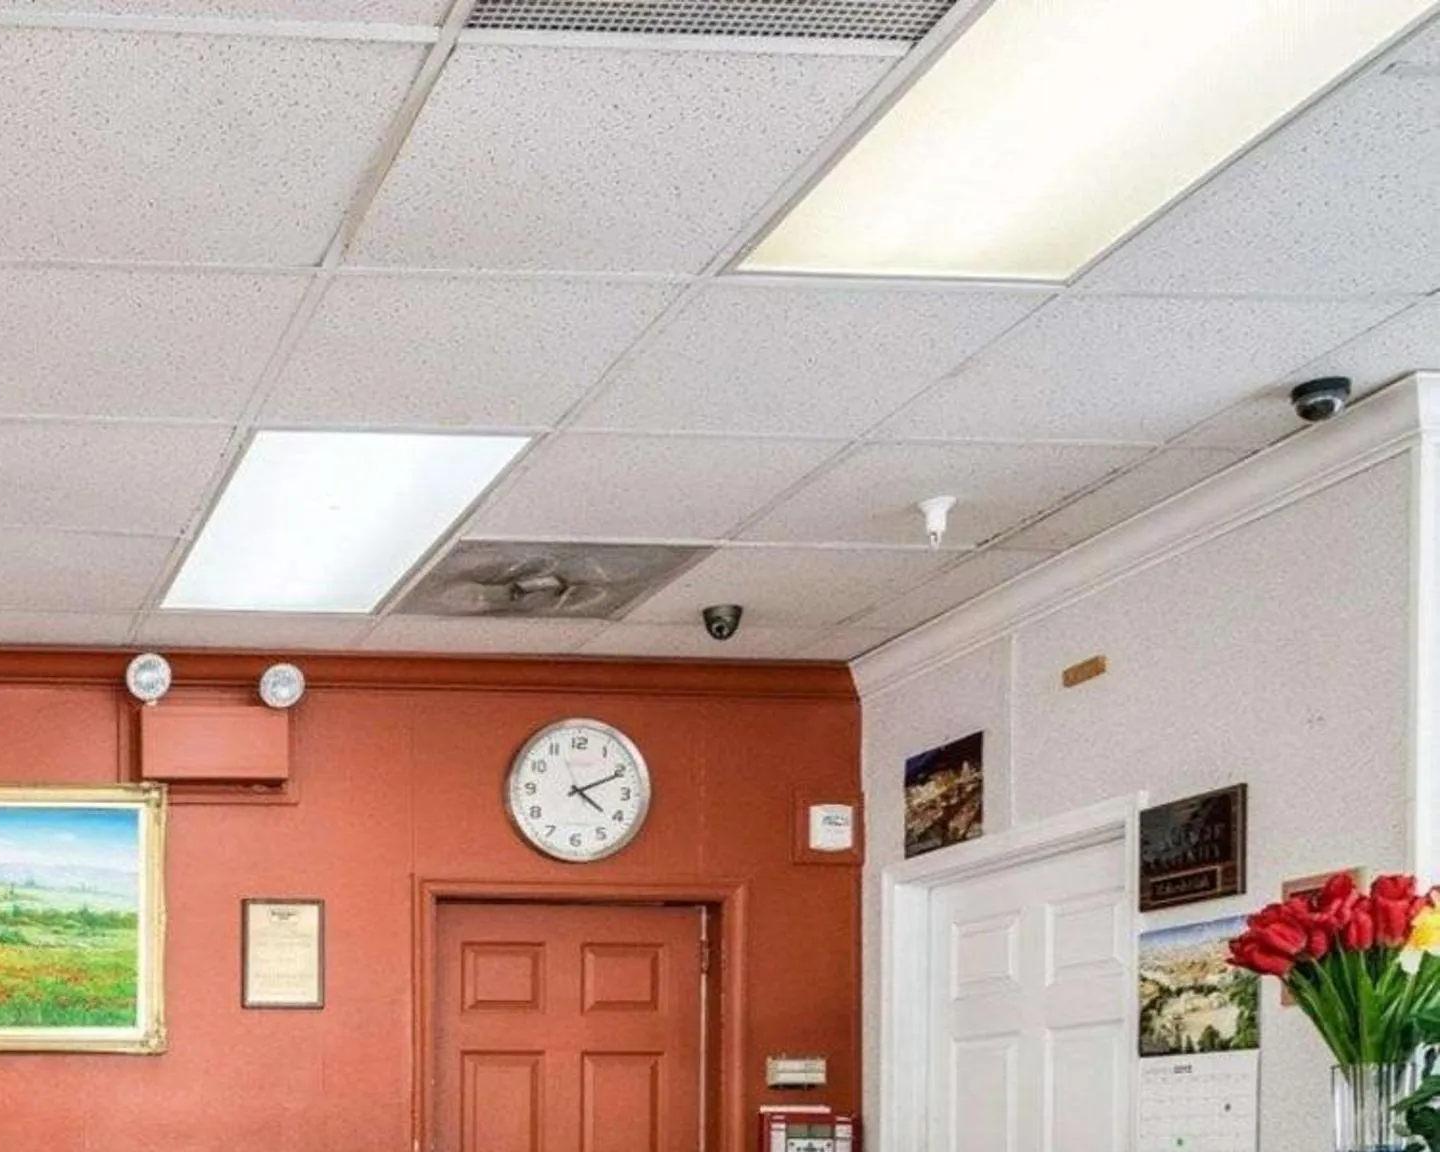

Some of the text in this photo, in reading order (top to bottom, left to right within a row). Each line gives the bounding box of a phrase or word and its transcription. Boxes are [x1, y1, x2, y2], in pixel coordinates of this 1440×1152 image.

[549, 743, 560, 756] 11
[571, 736, 588, 750] 12
[602, 746, 608, 759] 1
[531, 759, 547, 774] 10
[614, 764, 626, 778] 2
[524, 782, 537, 795] 9
[620, 787, 631, 801] 3
[529, 806, 542, 819] 8
[611, 810, 624, 822] 4
[545, 825, 556, 837] 7
[595, 827, 607, 840] 5
[569, 833, 582, 847] 6
